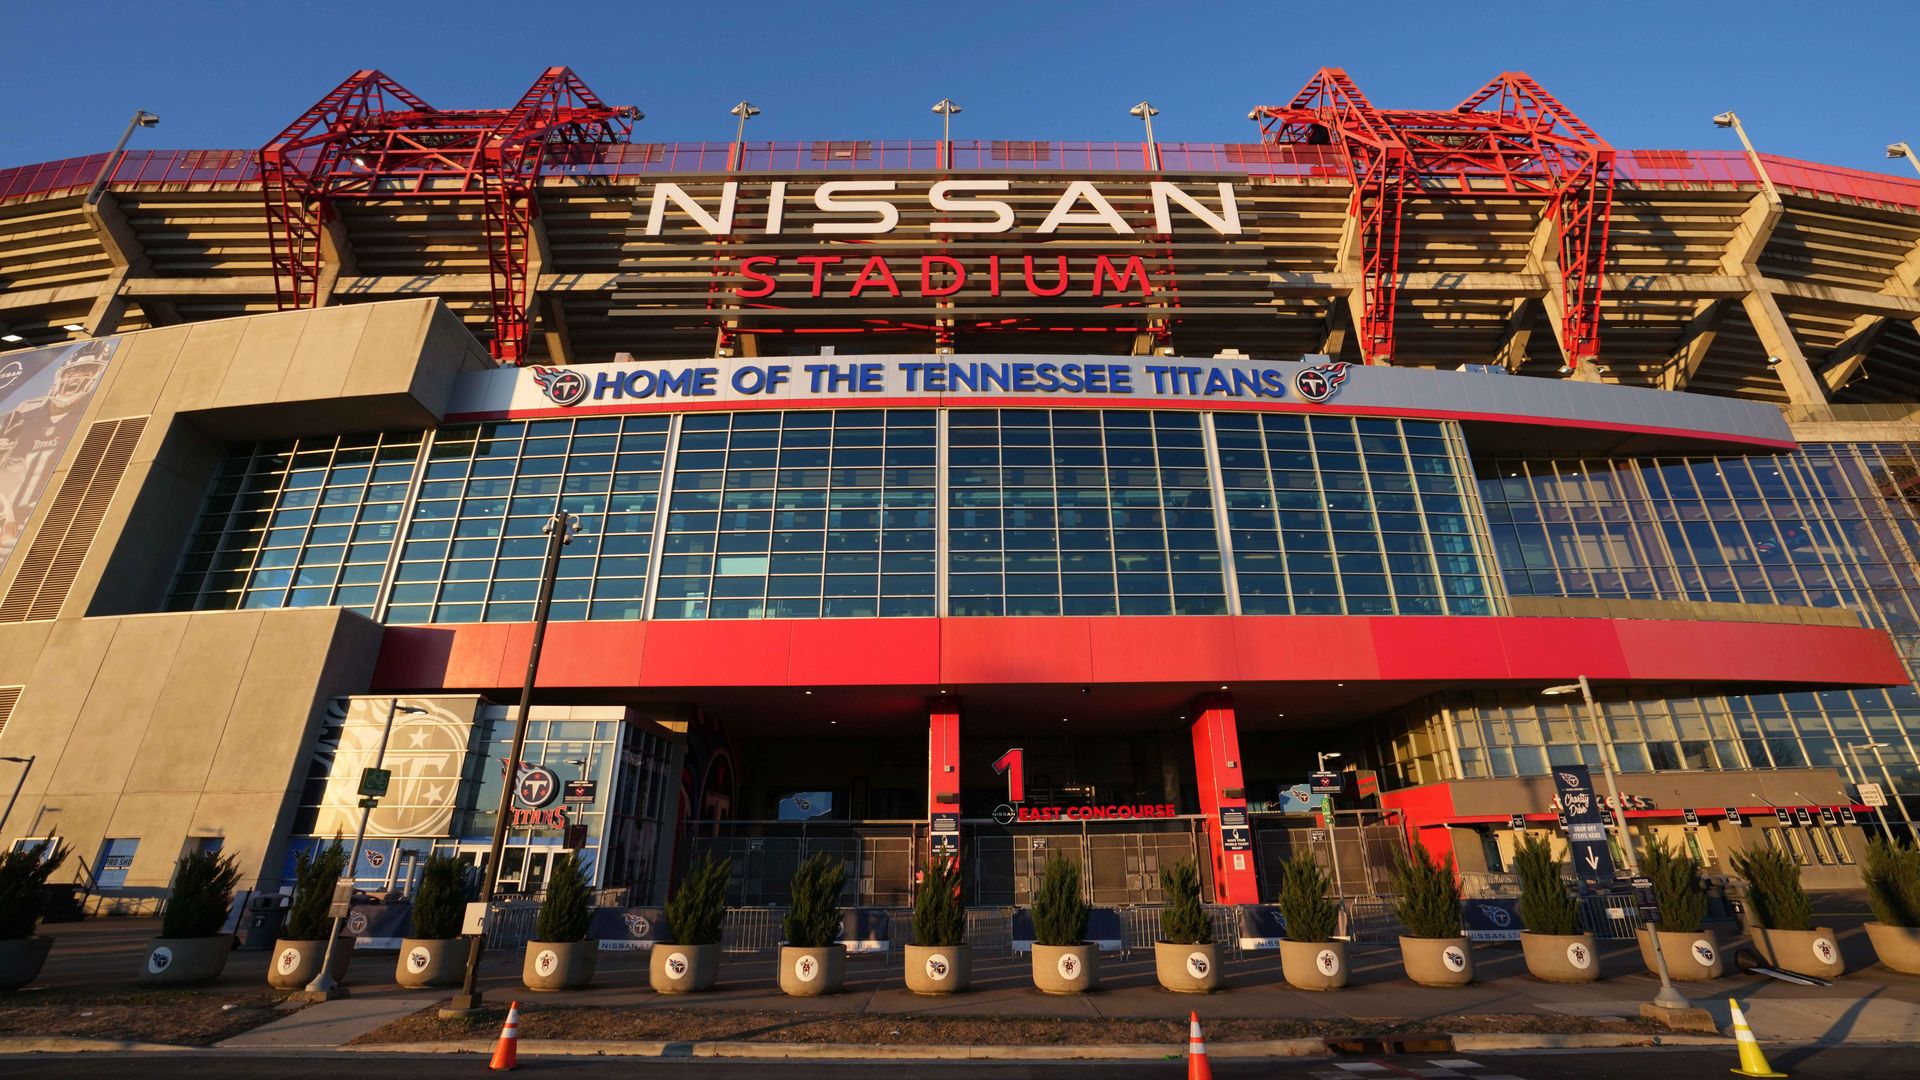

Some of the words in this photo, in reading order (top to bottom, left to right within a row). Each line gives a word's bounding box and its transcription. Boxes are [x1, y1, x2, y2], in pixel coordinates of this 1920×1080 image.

[645, 180, 1242, 235] NISSAN
[736, 255, 1152, 297] STADIUM
[593, 367, 718, 400] HOME
[731, 365, 790, 395] OF
[804, 363, 884, 393] THE
[899, 362, 1132, 394] TENNESSEE
[1145, 365, 1286, 398] TITANS
[992, 748, 1024, 803] 1
[1018, 807, 1062, 821] EAST
[1066, 804, 1176, 820] CONCOURSE
[1552, 791, 1646, 811] tets
[1564, 793, 1590, 812] Charity
[1568, 803, 1588, 817] Drive
[509, 805, 568, 830] ITANS
